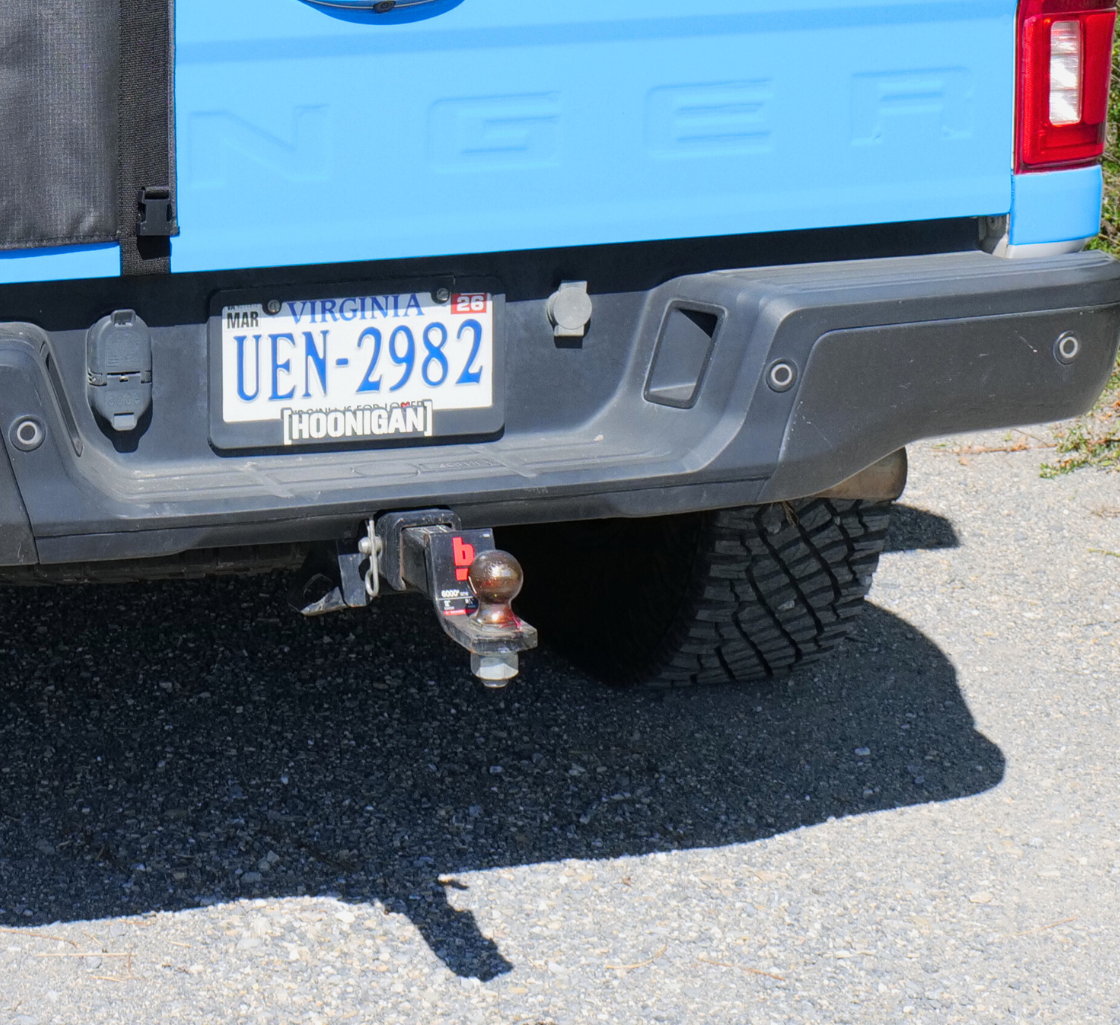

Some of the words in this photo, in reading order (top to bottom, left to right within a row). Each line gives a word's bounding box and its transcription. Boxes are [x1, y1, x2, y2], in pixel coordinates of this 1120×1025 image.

[286, 292, 425, 324] VIRGINIA
[456, 295, 484, 312] 26
[226, 311, 259, 329] MAR
[233, 319, 484, 402] UEN-2982
